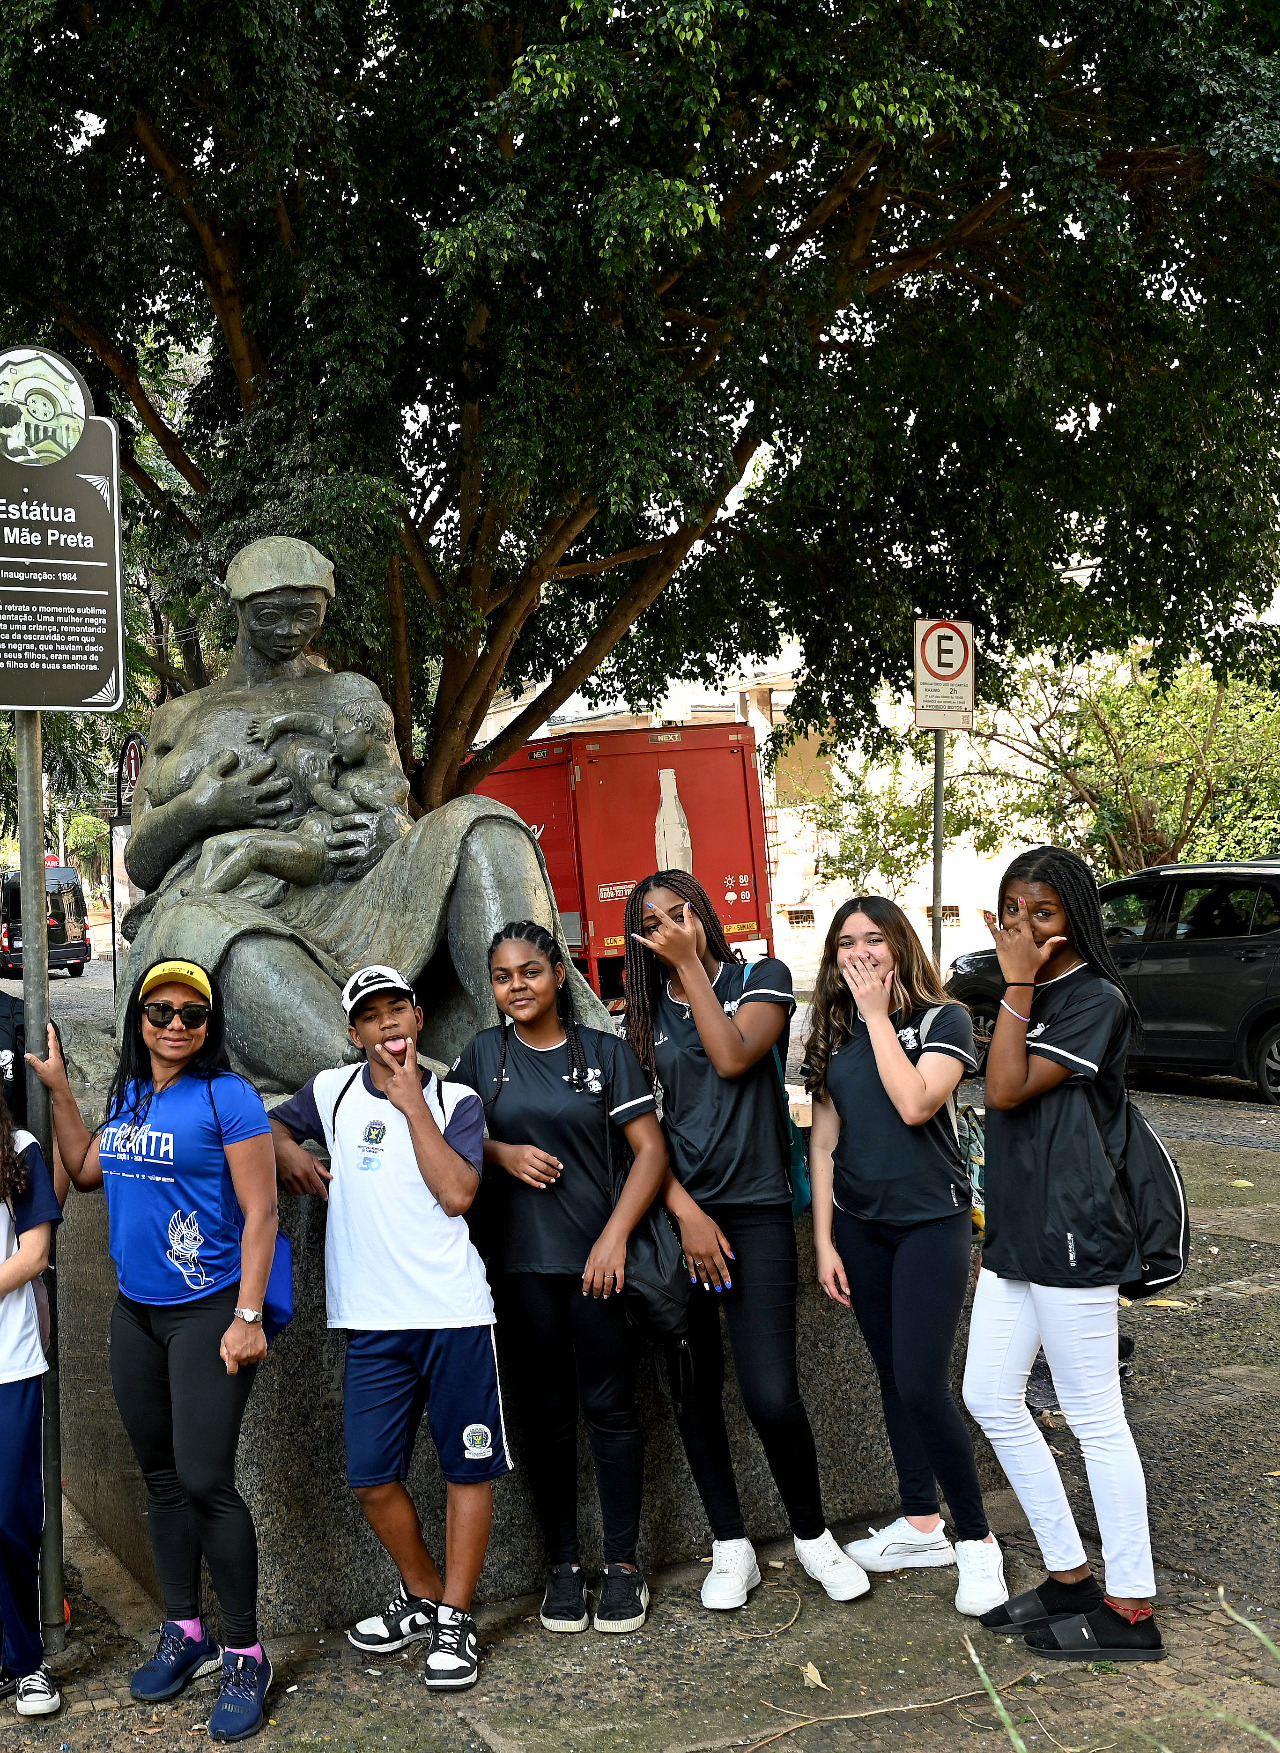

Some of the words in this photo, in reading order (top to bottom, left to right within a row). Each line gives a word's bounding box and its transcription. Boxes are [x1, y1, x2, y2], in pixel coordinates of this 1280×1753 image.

[4, 527, 41, 545] Mãe
[48, 529, 94, 548] Preta
[1, 570, 55, 581] Inauguração:
[58, 572, 77, 581] 1984
[39, 606, 75, 614] momento
[77, 606, 106, 614] sublime
[37, 614, 54, 622] Uma
[56, 614, 83, 623] mulher
[85, 618, 106, 626] negra
[61, 626, 106, 635] remontando
[56, 643, 82, 651] haviam
[938, 635, 953, 668] E
[6, 660, 28, 668] filhos
[658, 734, 679, 742] NEXT
[533, 750, 548, 758] NEXT
[739, 874, 748, 884] 80
[740, 890, 750, 900] 60
